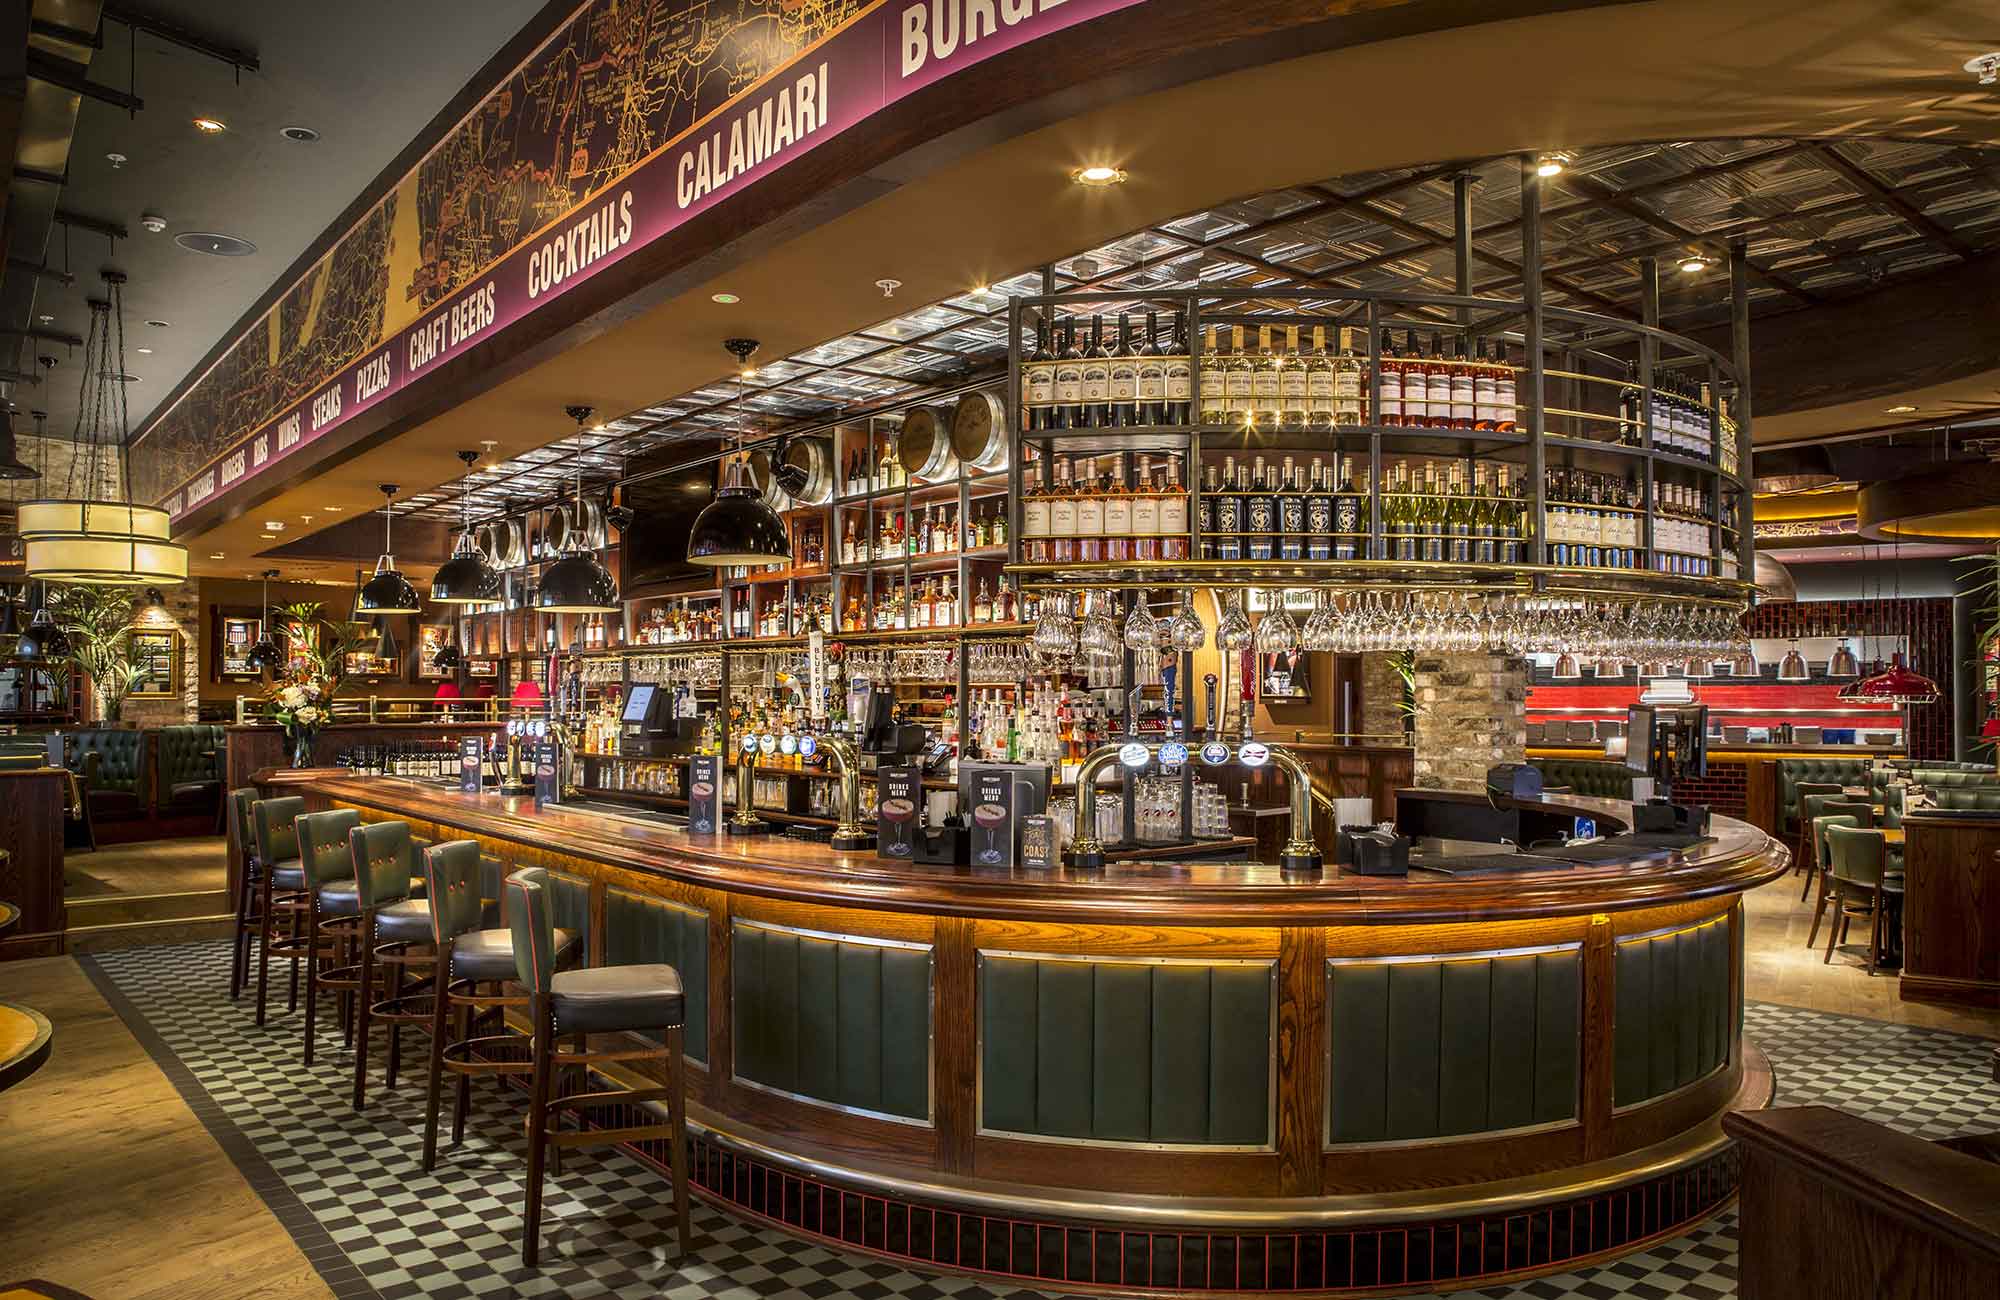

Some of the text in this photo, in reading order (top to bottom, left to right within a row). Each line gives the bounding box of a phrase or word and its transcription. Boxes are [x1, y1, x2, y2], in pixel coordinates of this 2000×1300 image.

[677, 62, 828, 209] CALAMARI
[528, 190, 633, 299] COCKTAILS
[409, 281, 496, 371] CRAFT BEERS
[312, 383, 342, 431] STEAKS
[356, 351, 391, 404] PIZZAS
[278, 411, 300, 451] WINGS
